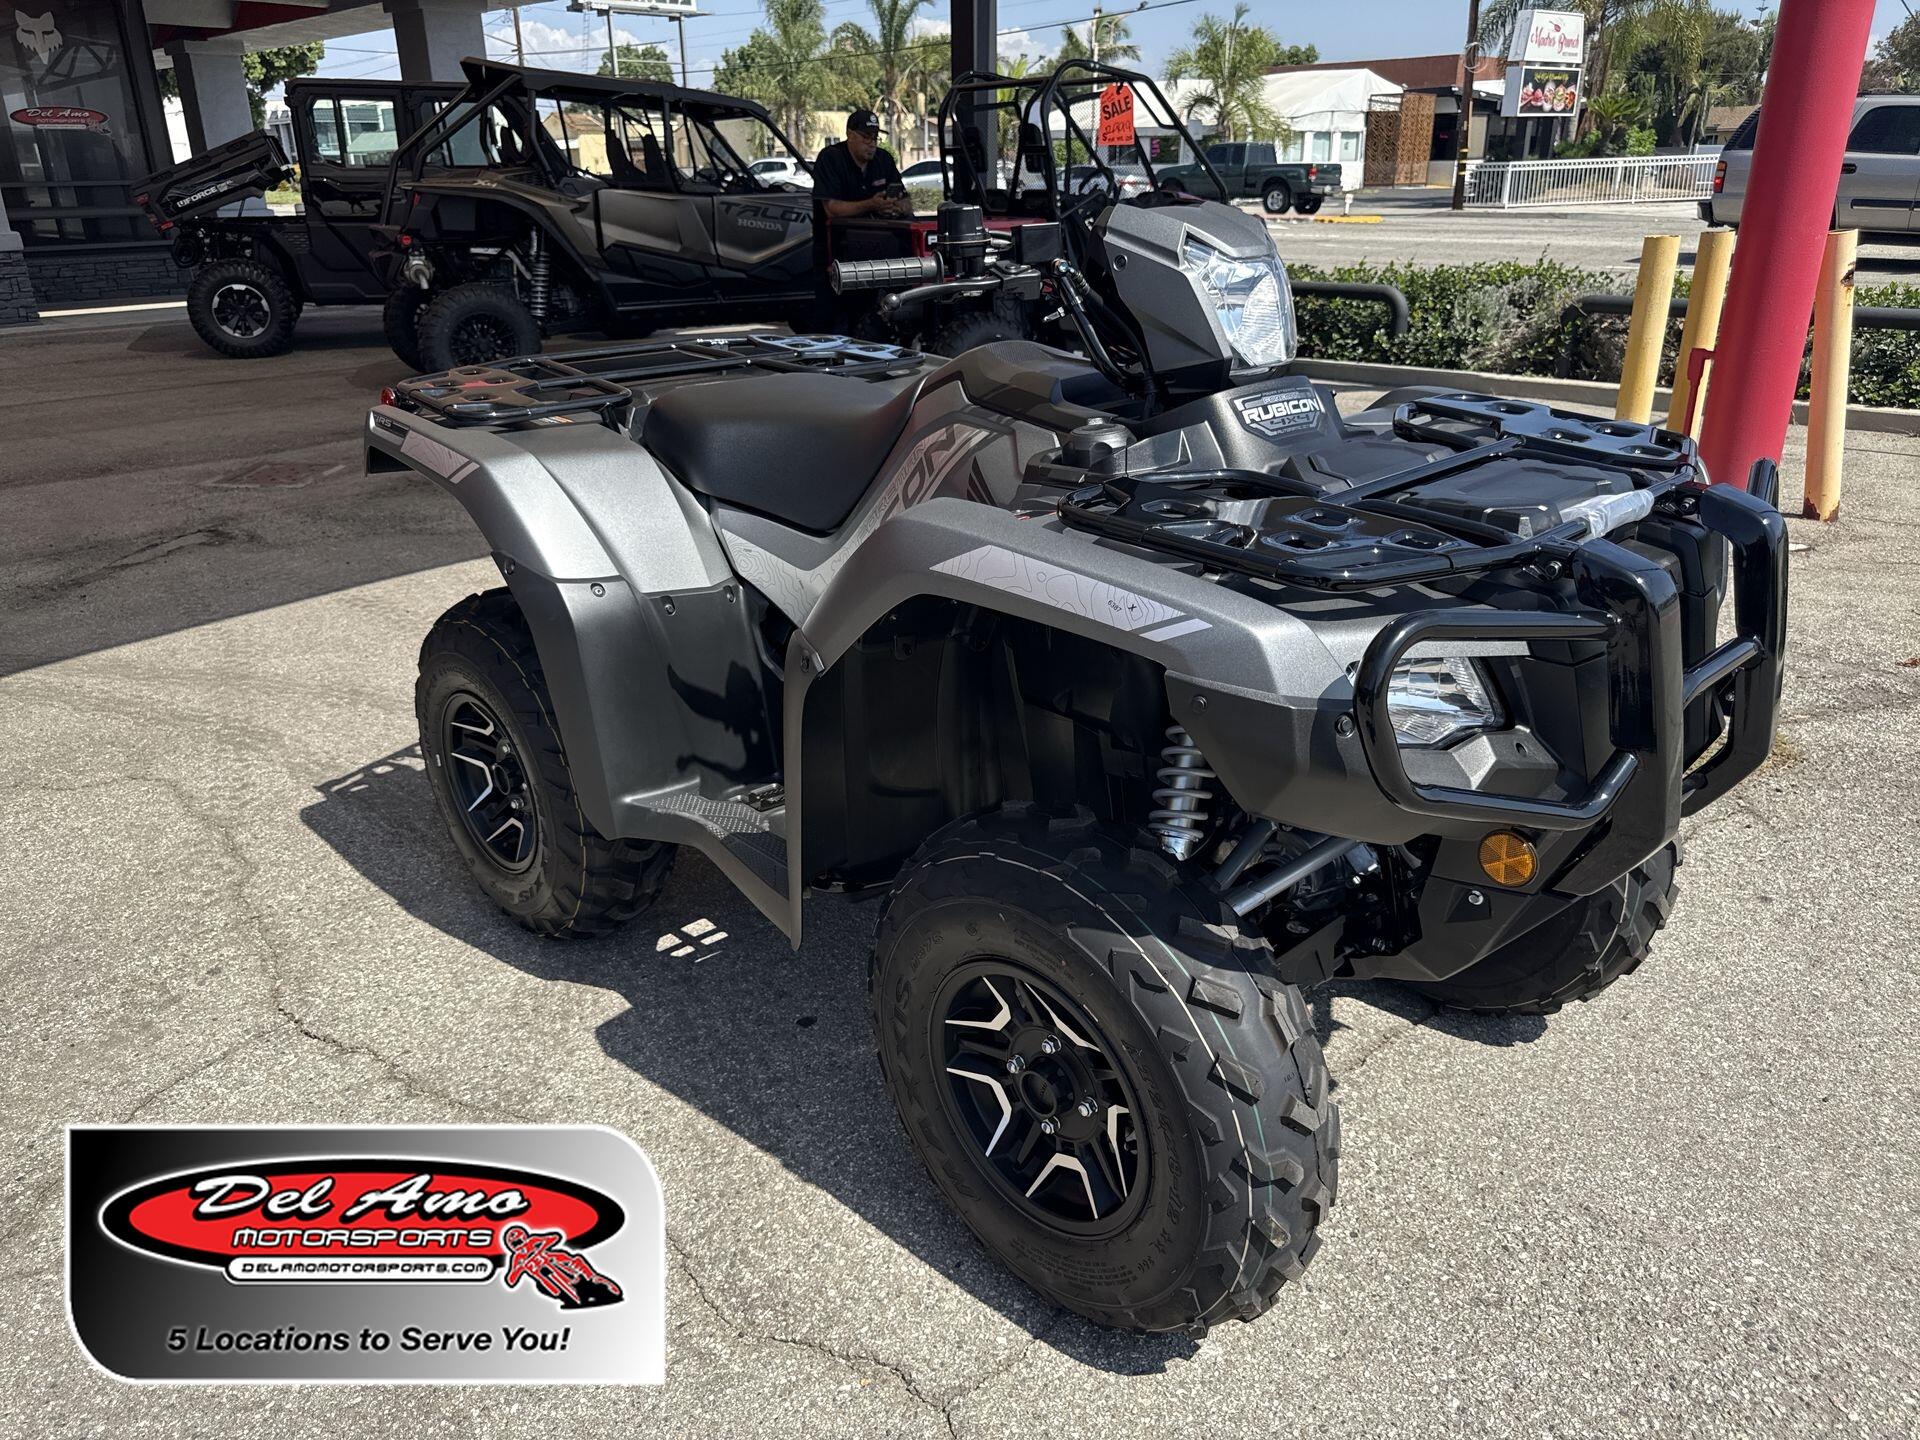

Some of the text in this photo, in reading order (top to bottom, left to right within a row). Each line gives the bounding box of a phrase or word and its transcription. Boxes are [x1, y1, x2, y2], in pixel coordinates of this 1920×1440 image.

[26, 108, 90, 118] Del Amo
[1102, 95, 1132, 121] SALE
[720, 201, 813, 224] TALON
[737, 218, 784, 232] HONDA
[1242, 398, 1321, 425] RUBICON
